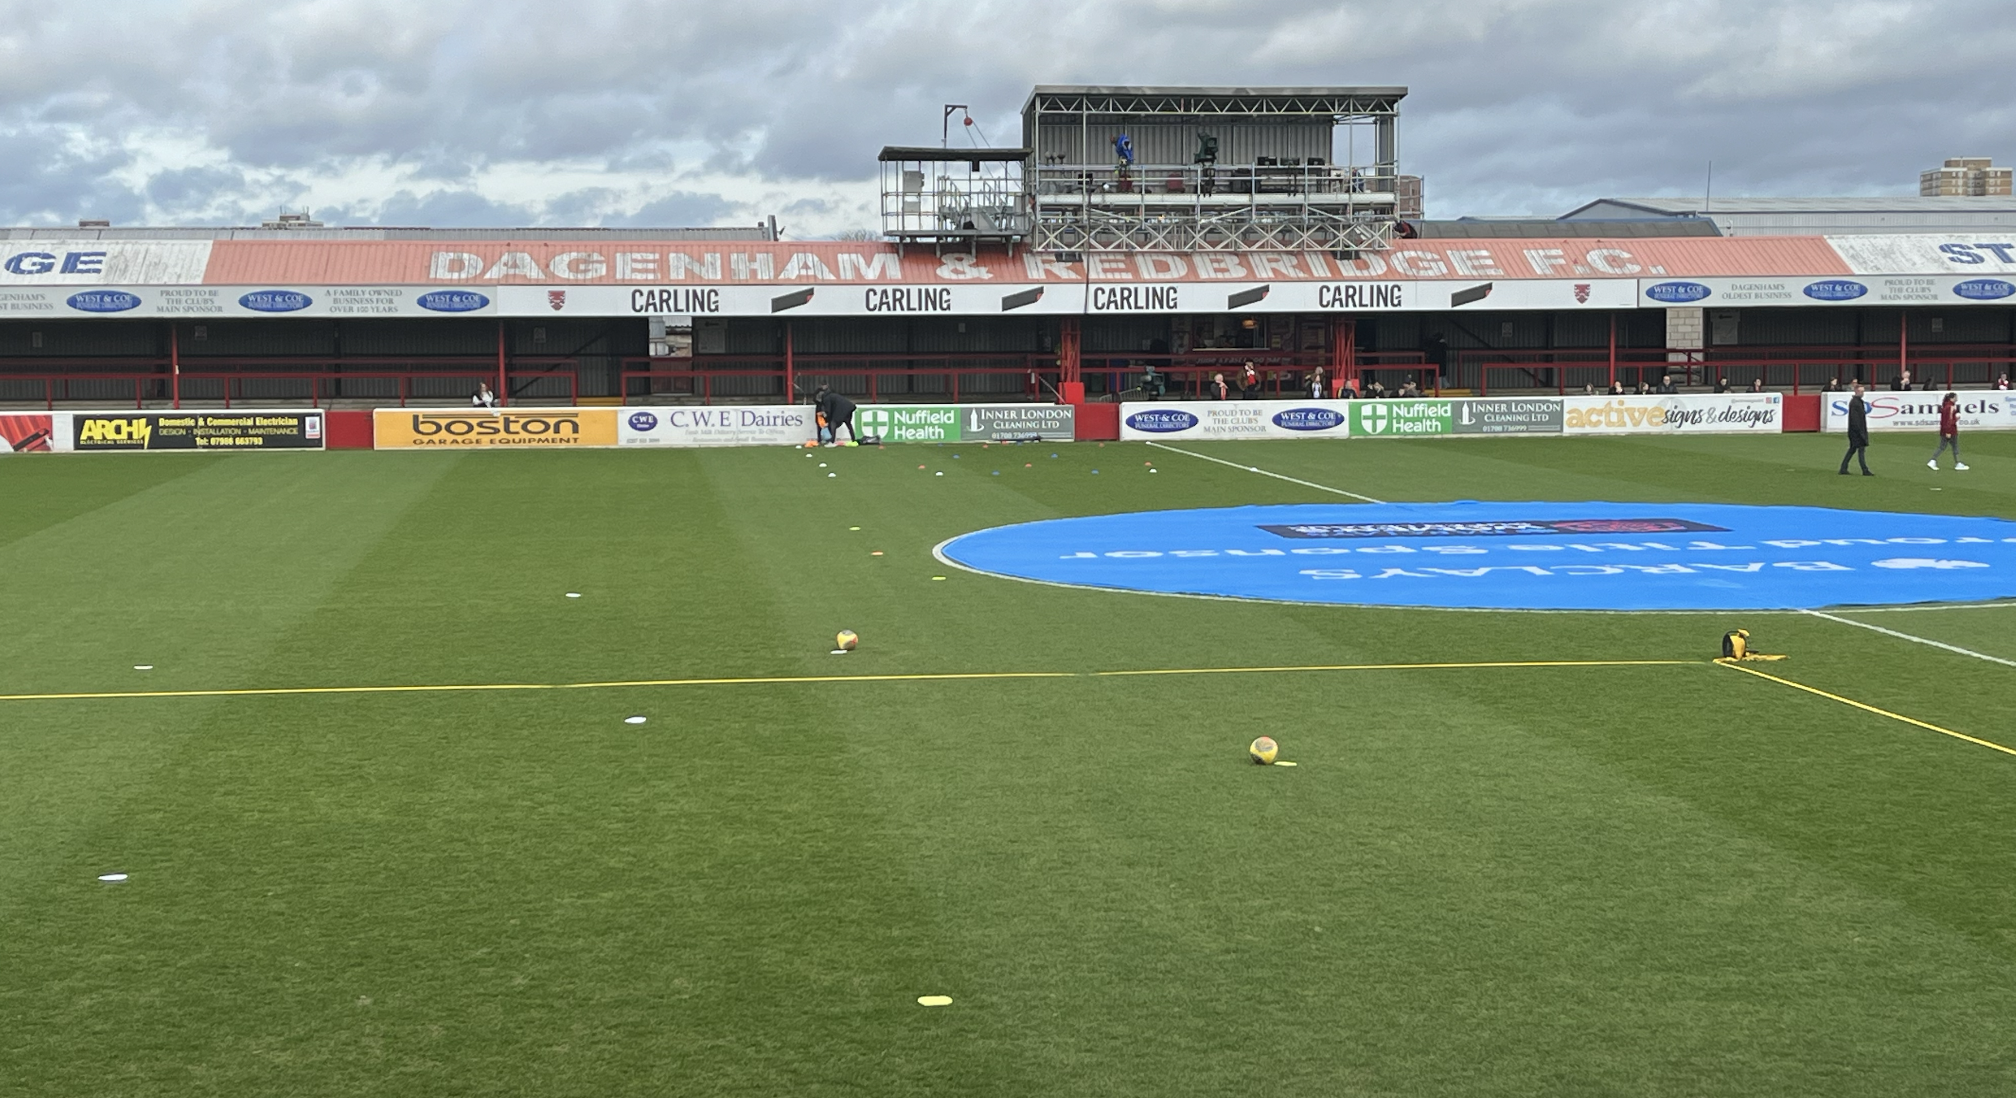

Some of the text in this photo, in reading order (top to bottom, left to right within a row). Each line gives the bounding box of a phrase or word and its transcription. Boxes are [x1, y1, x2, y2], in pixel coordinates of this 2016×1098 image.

[1938, 243, 2015, 264] ST
[4, 251, 107, 274] GE
[429, 248, 1666, 280] DAGENHAM & REDBRIDGE F.C.
[325, 289, 402, 297] A FAMILY OWNED
[1677, 285, 1686, 293] &
[104, 294, 112, 303] &
[275, 294, 283, 303] &
[452, 294, 461, 303] &
[631, 289, 719, 313] CARLING
[865, 288, 951, 311] CARLING
[1094, 286, 1178, 310] CARLING
[1319, 284, 1402, 309] CARLING
[1392, 403, 1451, 417] Nuffield
[1472, 402, 1561, 412] INNER LONDON
[631, 415, 654, 423] CWE
[741, 410, 803, 427] Dairies
[894, 410, 954, 424] Nuffield
[981, 409, 1072, 420] INNER LONDON
[1135, 414, 1190, 422] WEST & COE
[1280, 412, 1336, 420] WEST & COE
[1484, 413, 1549, 422] CLEANING LTD
[1565, 400, 1775, 429] active signs & designs
[158, 417, 298, 427] Domestic & Commercial Electrician
[412, 414, 579, 435] boston
[993, 420, 1059, 429] CLEANING LTD
[1212, 417, 1229, 425] THE
[1392, 418, 1441, 433] Health
[159, 428, 186, 436] DESIGN
[193, 428, 241, 436] INSTALLATION
[248, 428, 298, 436] MAINTENANCE
[894, 426, 944, 440] Health
[1204, 425, 1267, 433] MAIN SPONSOR
[195, 437, 209, 446] Tel:
[413, 437, 579, 445] GARAGE EQUIPMENT
[1059, 545, 1488, 559] Sponsor
[1507, 541, 1755, 552] Title
[1300, 562, 1855, 579] BARCLAYS
